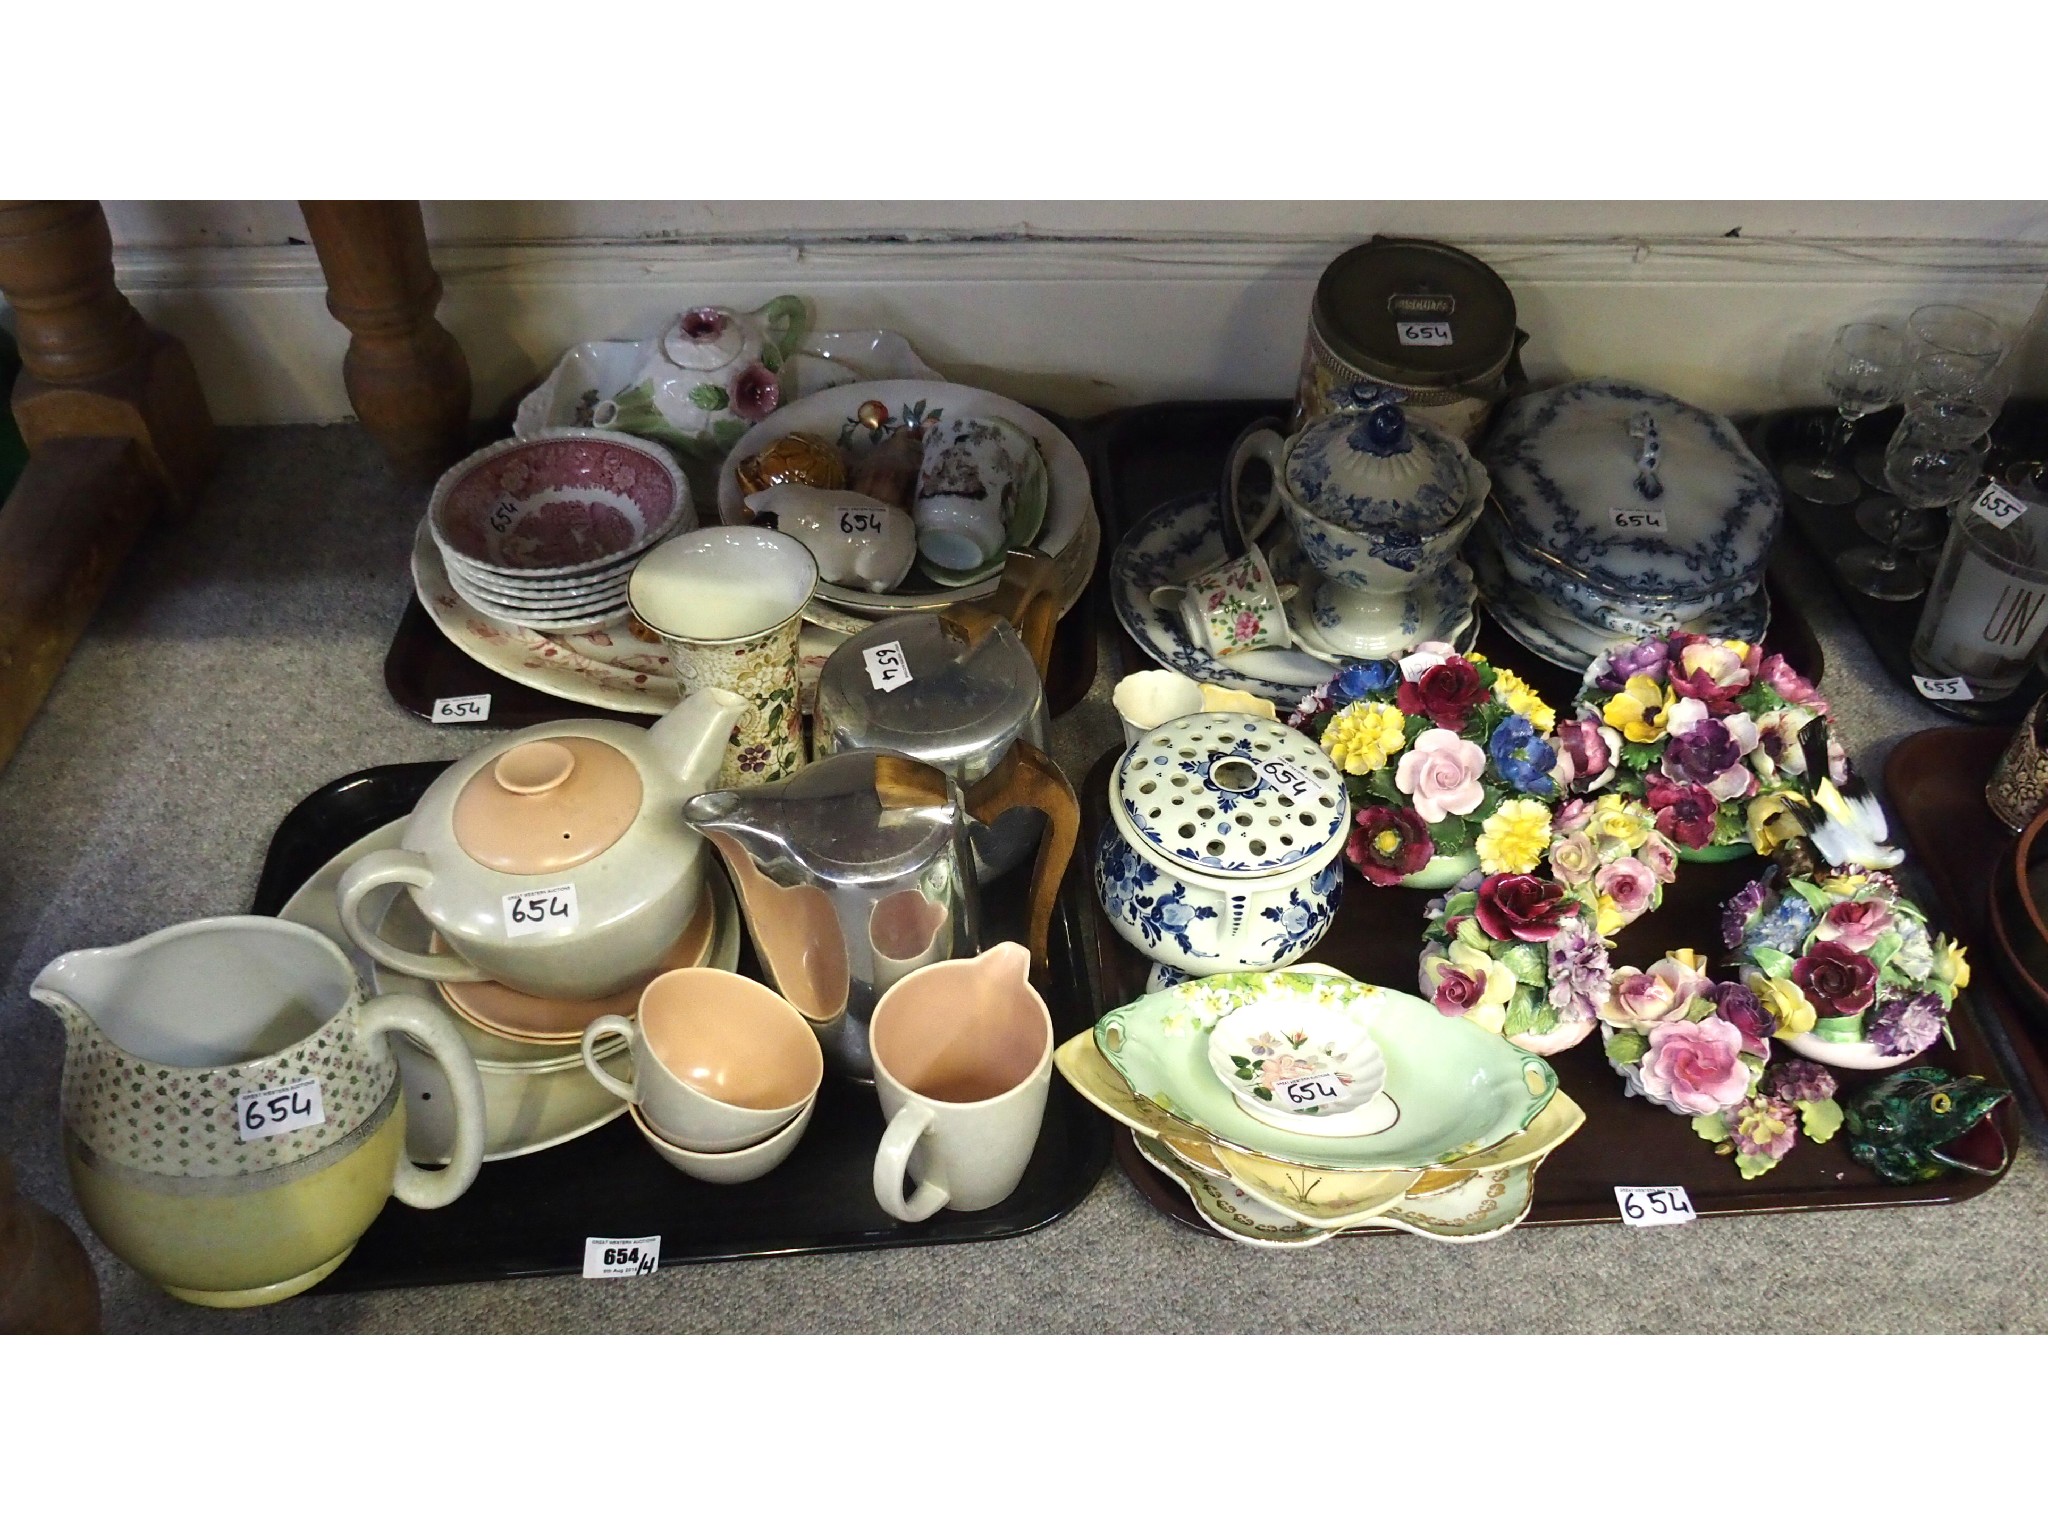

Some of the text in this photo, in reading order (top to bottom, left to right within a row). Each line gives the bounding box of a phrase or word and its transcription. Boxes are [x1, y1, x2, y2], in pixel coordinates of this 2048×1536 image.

[1406, 326, 1447, 339] 654
[491, 502, 518, 532] 654
[1980, 491, 2020, 517] 655
[841, 512, 881, 533] 654
[1615, 513, 1660, 527] 654
[876, 650, 899, 680] 654
[1923, 681, 1958, 695] 655
[441, 702, 480, 717] 654
[1263, 763, 1307, 796] 654
[512, 896, 568, 923] 654
[1287, 1083, 1337, 1103] 654
[245, 1092, 311, 1130] 654
[1625, 1191, 1689, 1219] 654
